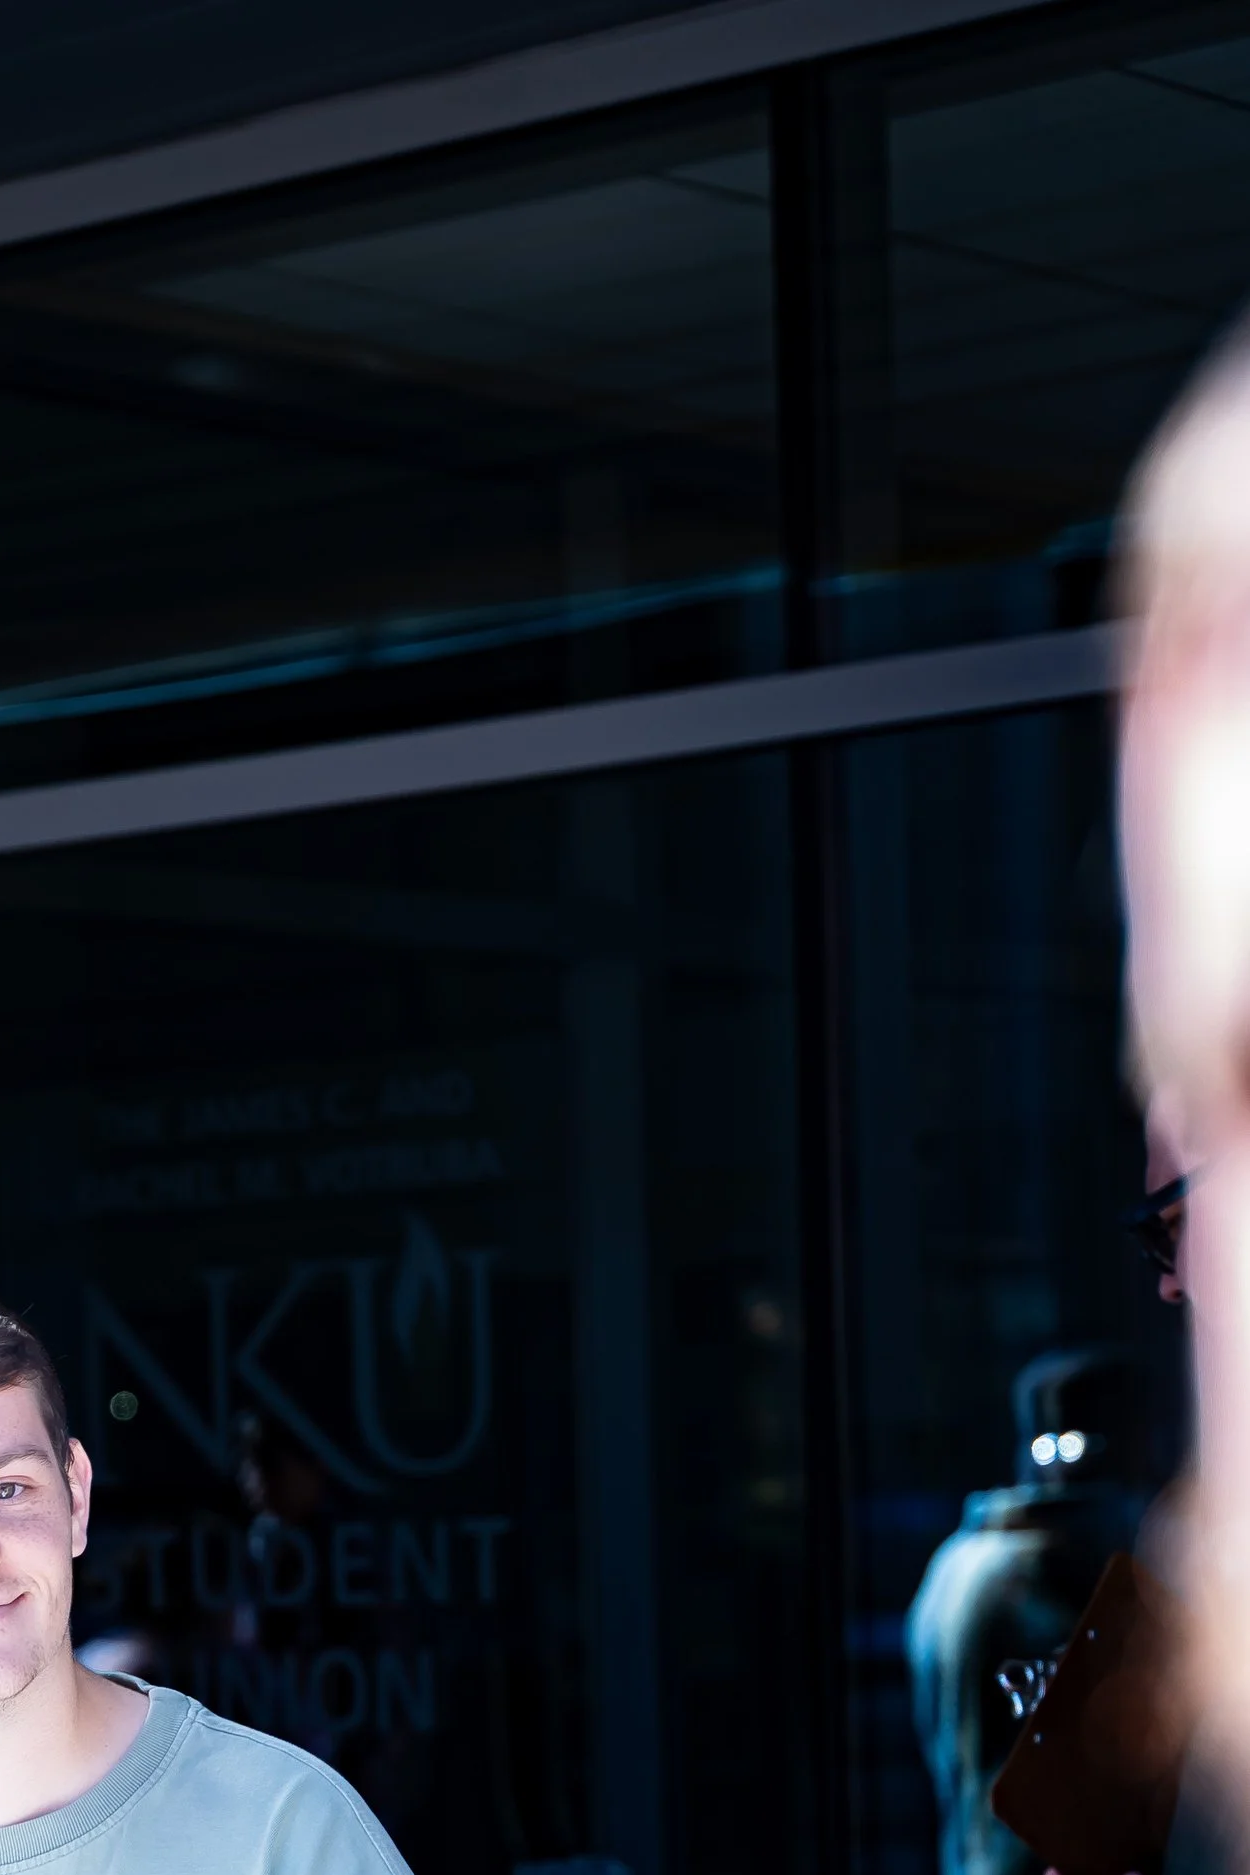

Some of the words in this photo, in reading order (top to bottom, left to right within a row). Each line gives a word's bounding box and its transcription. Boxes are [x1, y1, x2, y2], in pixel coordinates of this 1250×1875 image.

[82, 1246, 506, 1495] NKU
[79, 1509, 512, 1612] STUDENT
[187, 1637, 438, 1734] NION
